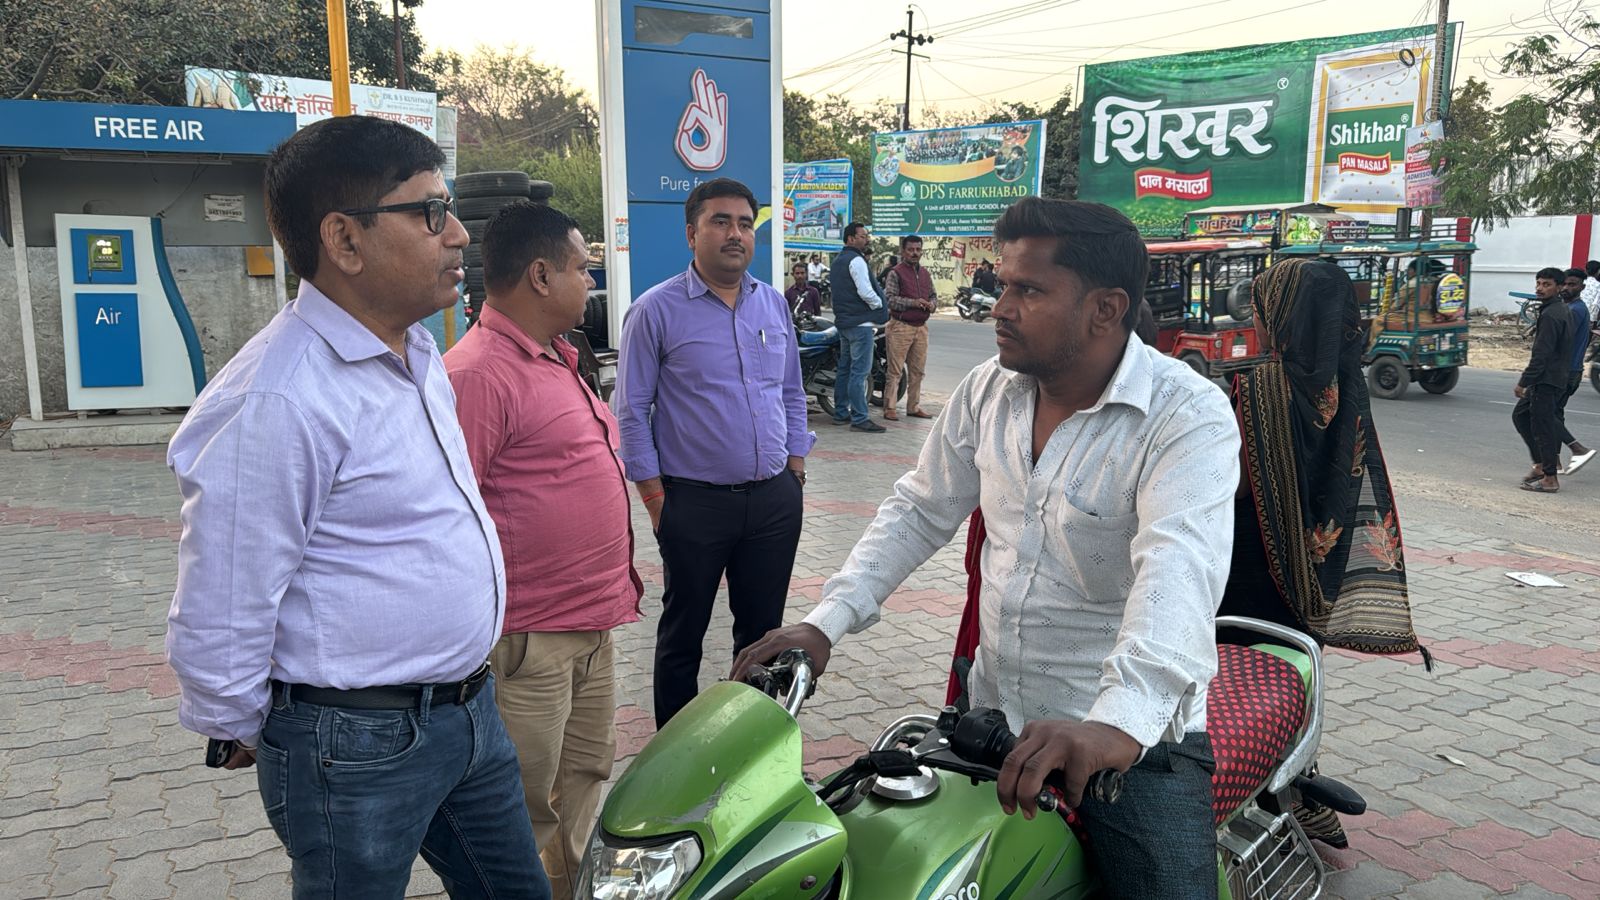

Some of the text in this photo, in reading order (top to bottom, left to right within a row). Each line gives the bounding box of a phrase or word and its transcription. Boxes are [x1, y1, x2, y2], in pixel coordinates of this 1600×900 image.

[94, 116, 205, 141] FREE AIR
[1092, 95, 1274, 164] शिखर
[1329, 121, 1408, 146] Shikhar
[1341, 157, 1388, 171] PAN MASALA
[660, 176, 690, 191] Pure
[1138, 174, 1209, 194] पान मसाला
[1407, 170, 1433, 180] ADMISSIO
[919, 183, 946, 200] DPS
[949, 185, 1028, 199] FARRUKHABAD
[95, 307, 122, 325] Air
